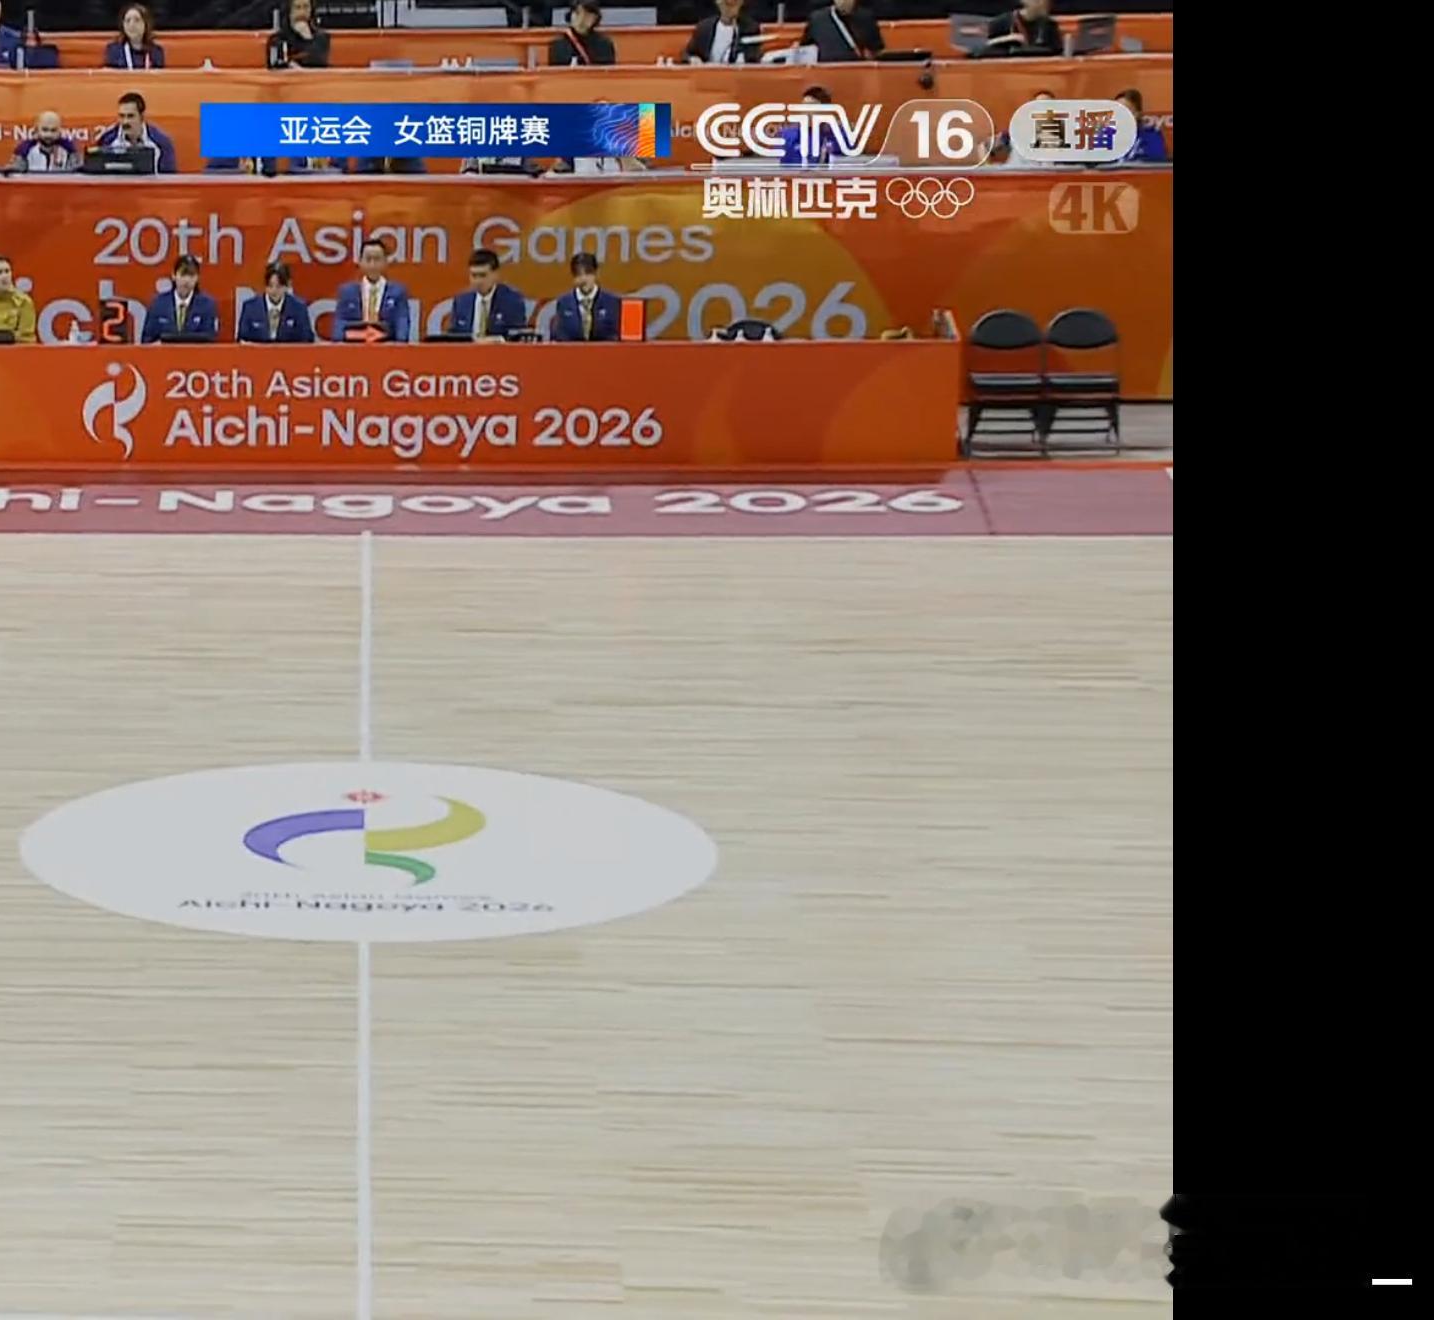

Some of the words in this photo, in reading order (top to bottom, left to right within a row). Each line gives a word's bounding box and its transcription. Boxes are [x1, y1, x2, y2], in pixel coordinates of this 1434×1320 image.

[92, 212, 245, 266] 20th
[267, 209, 448, 266] Asian
[472, 215, 715, 265] Games
[165, 370, 253, 399] 20th
[265, 366, 369, 399] Asian
[382, 369, 520, 399] Games
[165, 403, 517, 457] Aichi-Nagoya
[532, 407, 664, 447] 2026
[653, 490, 965, 515] 2026
